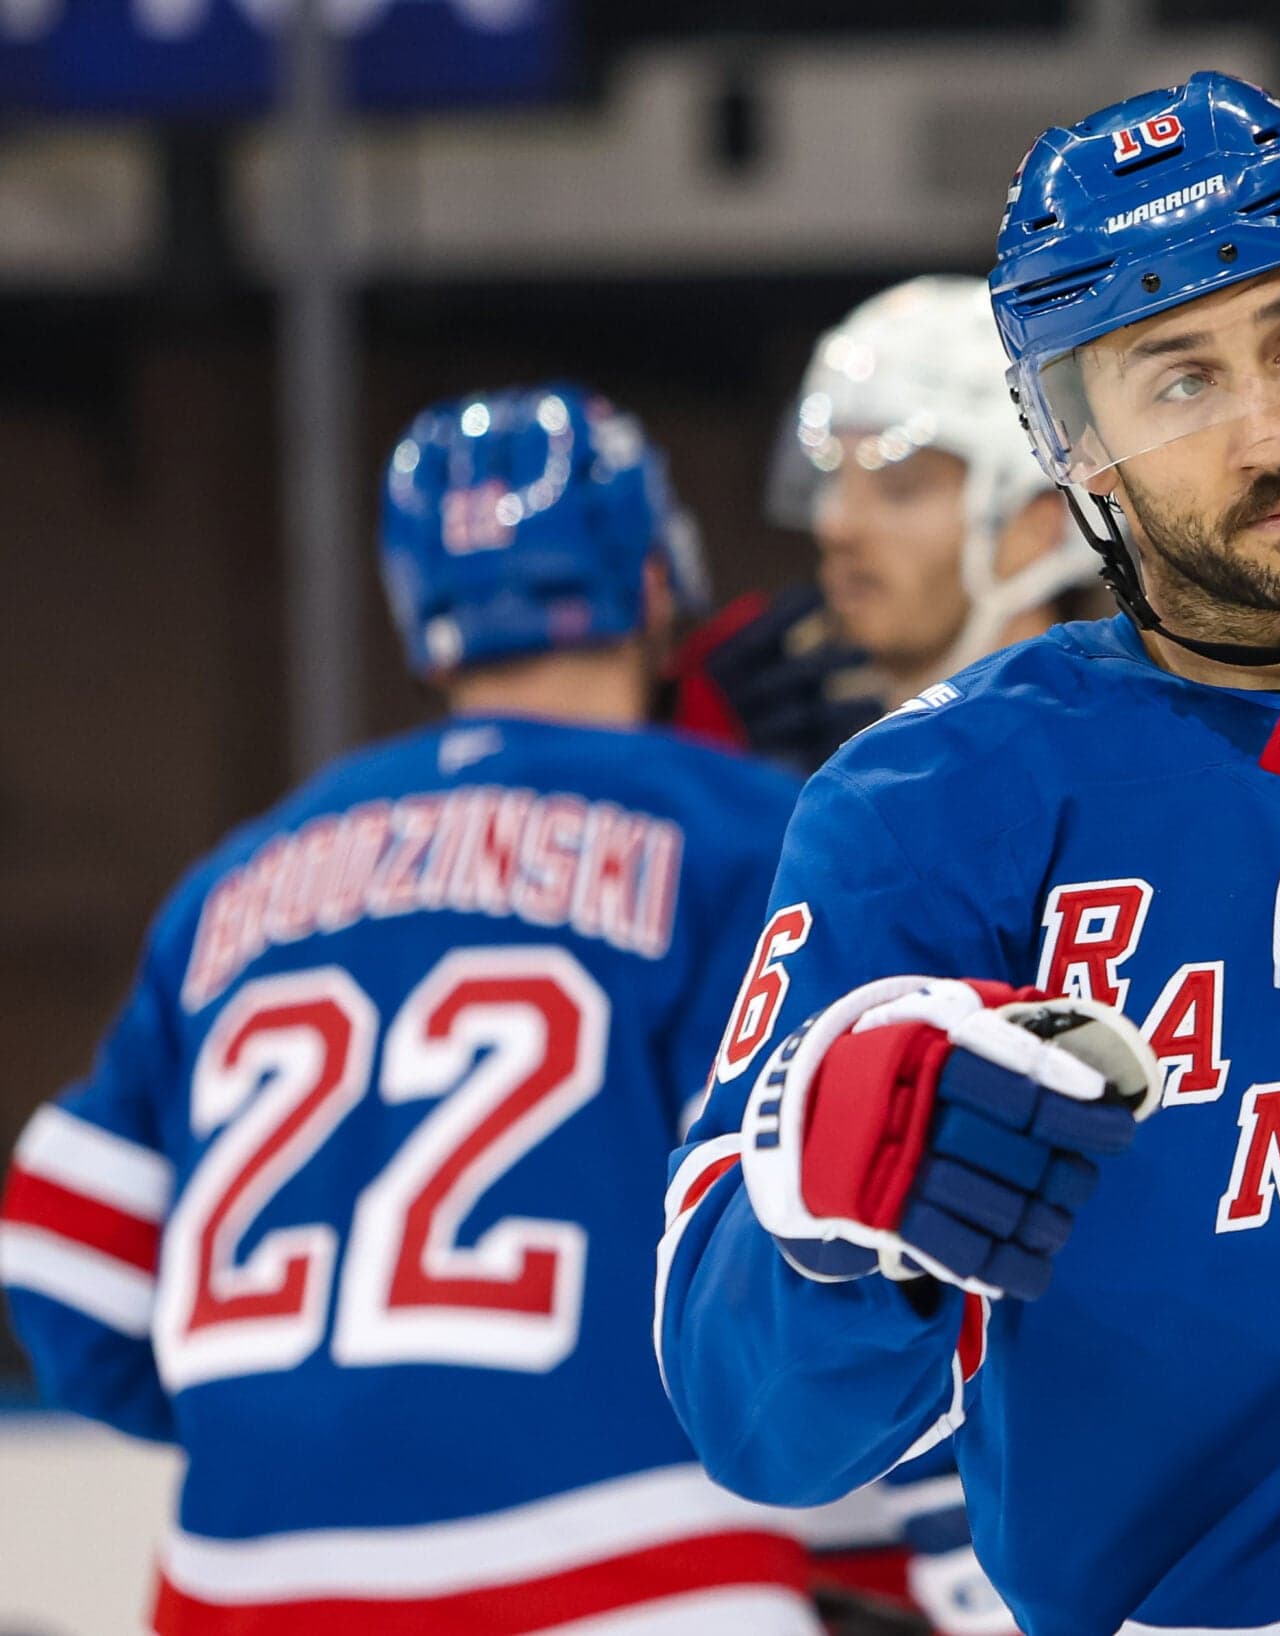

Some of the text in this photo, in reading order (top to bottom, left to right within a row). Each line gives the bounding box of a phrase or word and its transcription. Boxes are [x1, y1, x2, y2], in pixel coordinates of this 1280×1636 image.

[1107, 173, 1226, 235] WARRIOR
[706, 900, 814, 1086] 6
[151, 944, 612, 1392] 22
